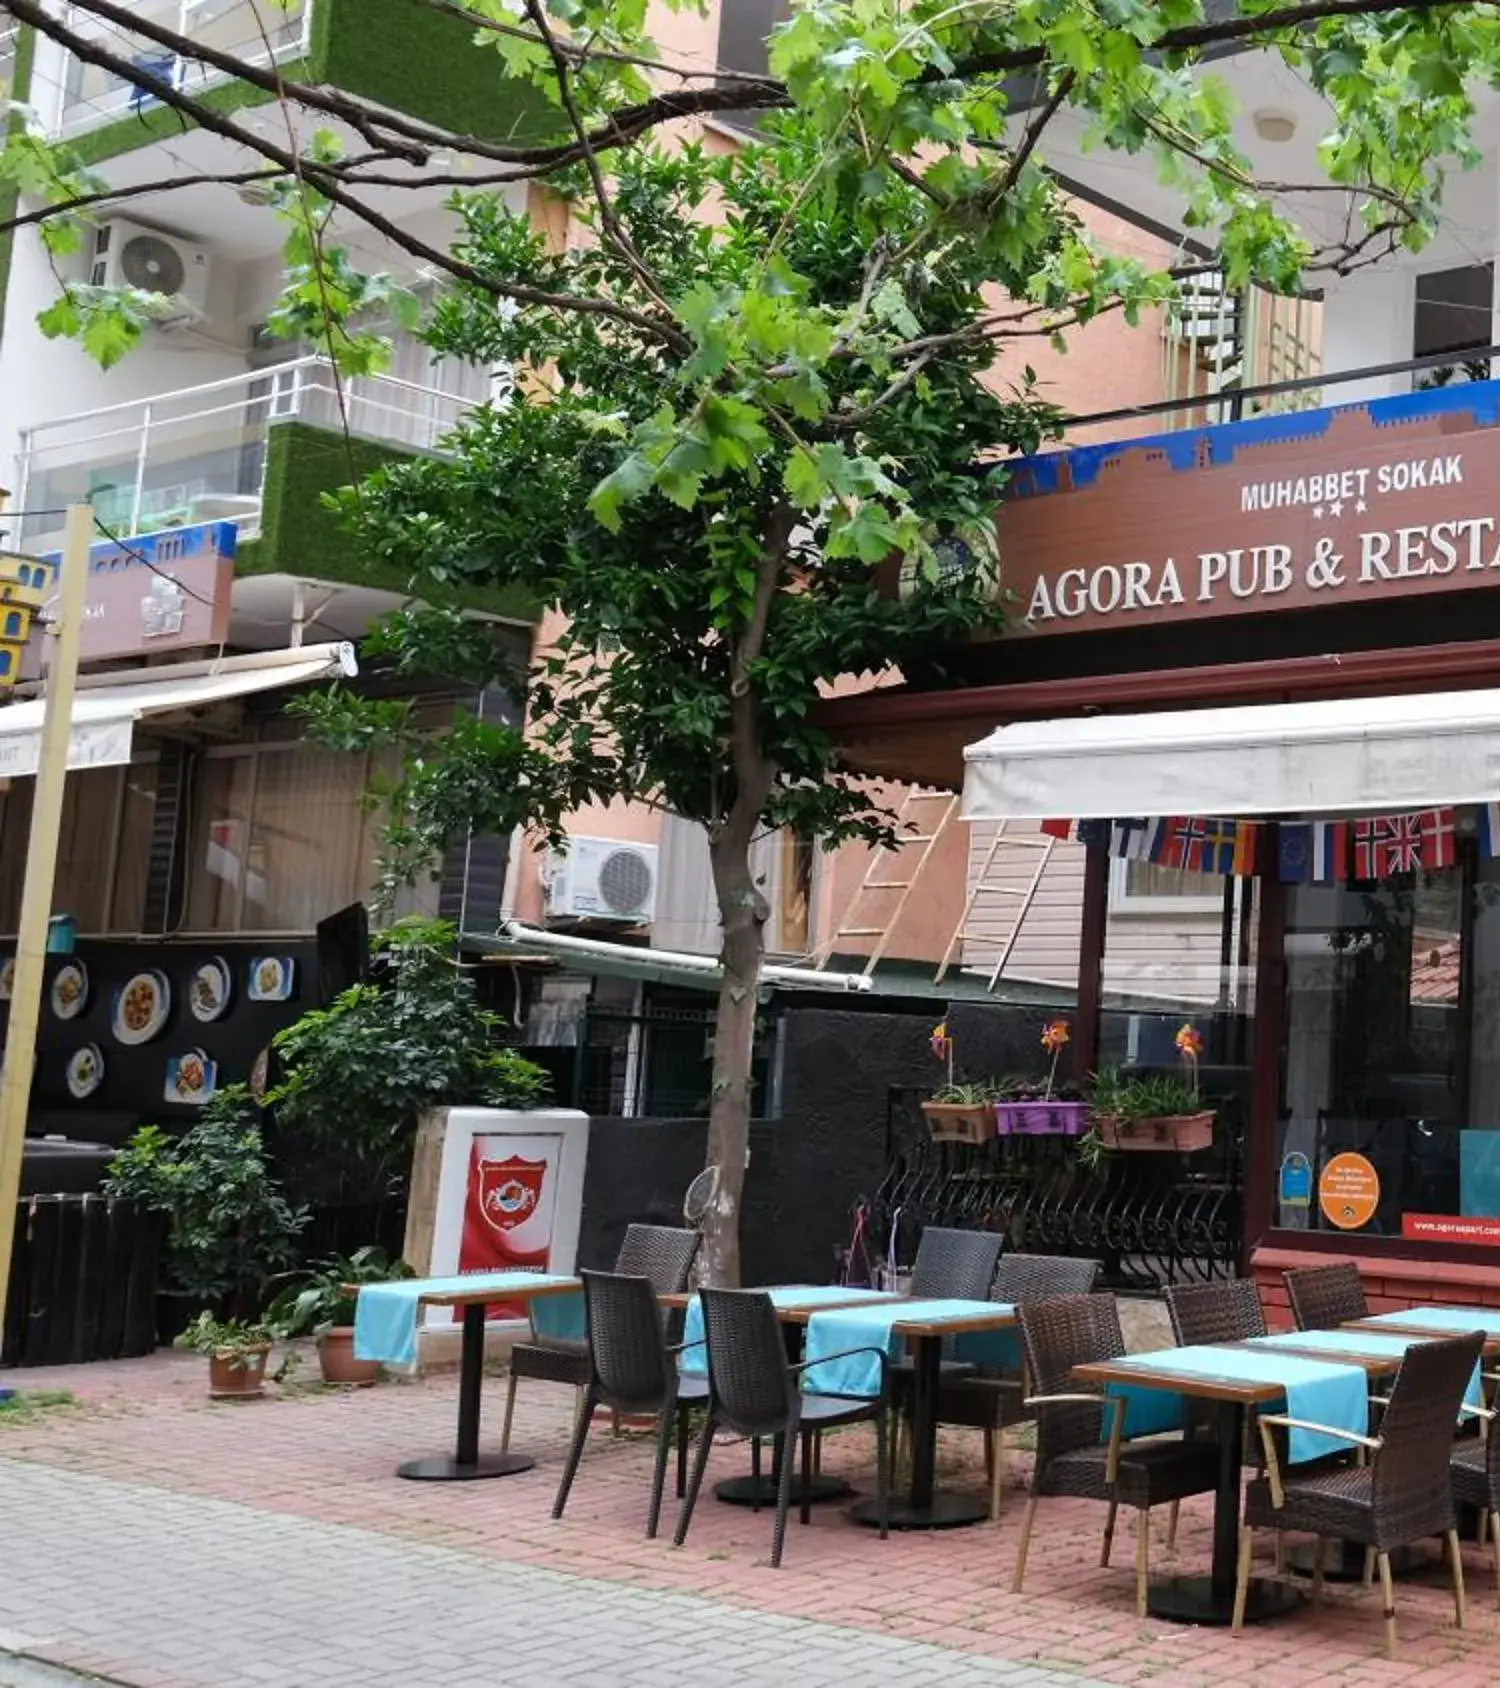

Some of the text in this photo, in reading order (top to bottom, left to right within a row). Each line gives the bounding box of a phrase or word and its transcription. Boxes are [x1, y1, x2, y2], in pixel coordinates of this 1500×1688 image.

[1241, 454, 1463, 512] MUHABBET SOKAK
[1025, 558, 1186, 621] AGORA
[1197, 544, 1293, 601] PUB
[1305, 537, 1347, 590] &
